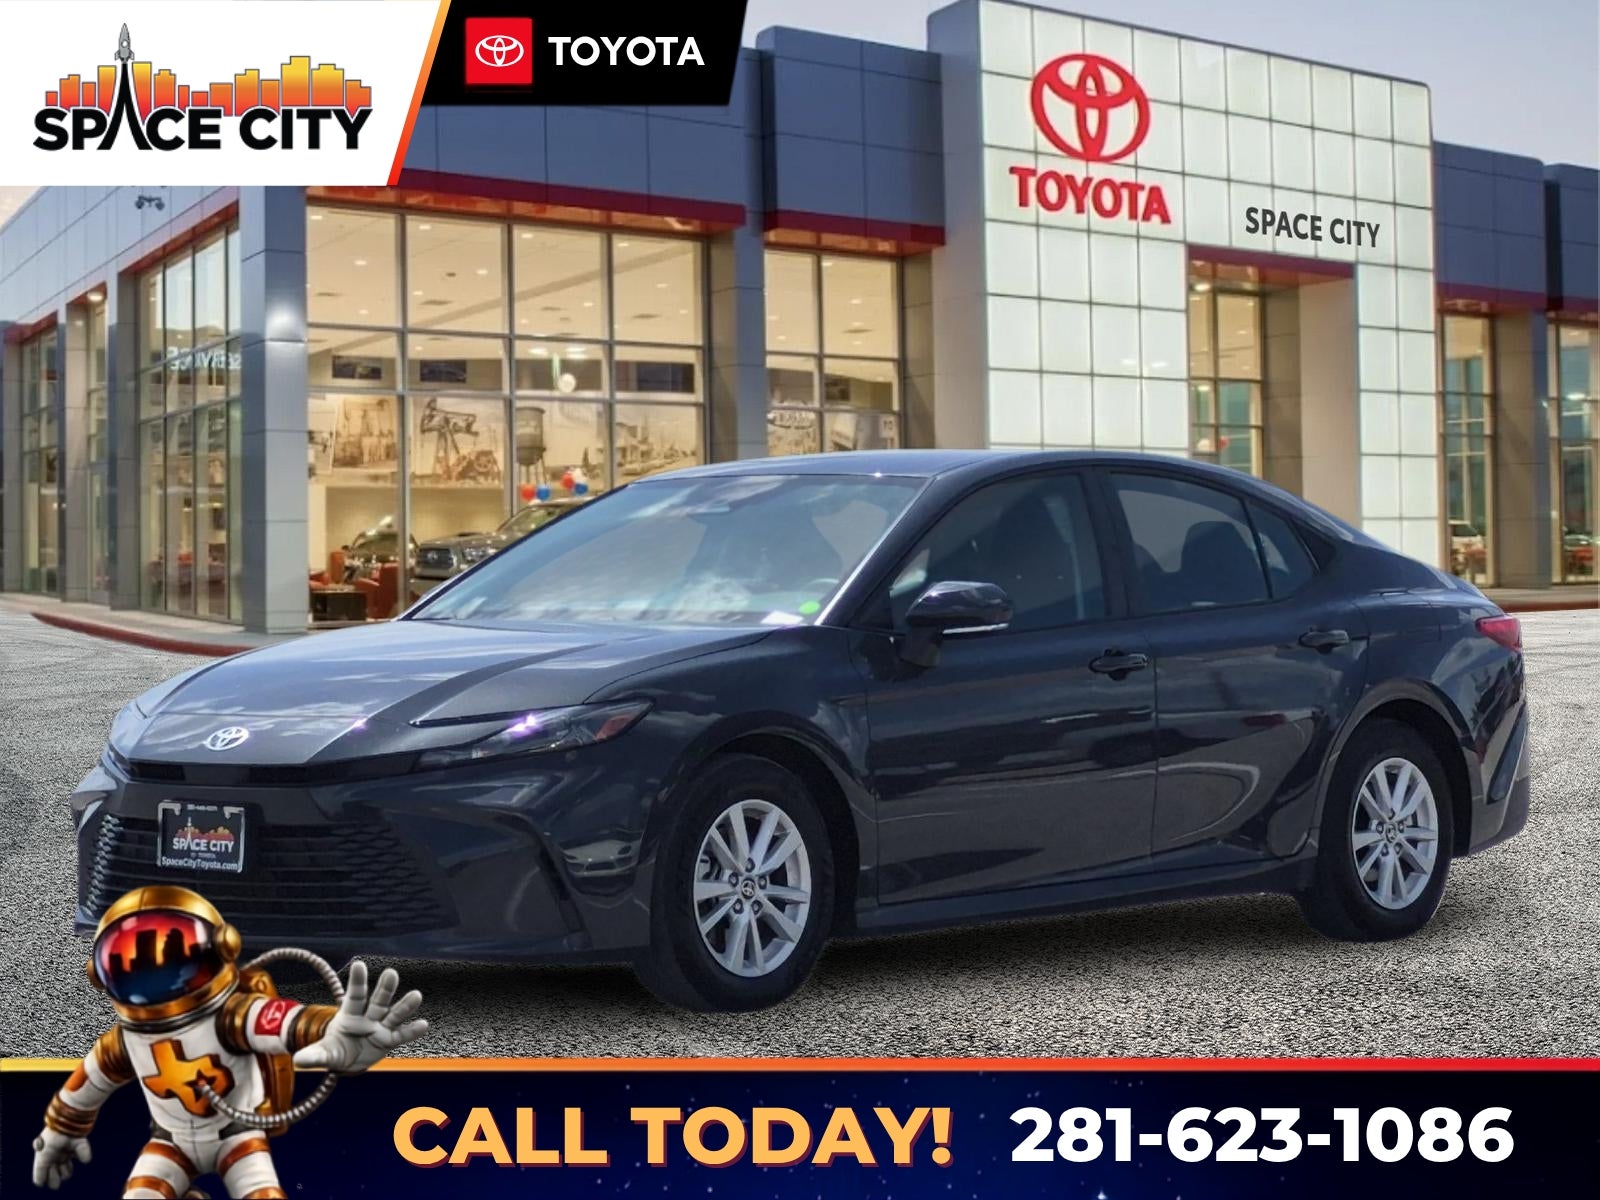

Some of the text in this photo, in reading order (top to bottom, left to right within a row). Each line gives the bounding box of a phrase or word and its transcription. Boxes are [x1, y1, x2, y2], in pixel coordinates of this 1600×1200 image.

[1009, 165, 1172, 225] TOYOTA
[1245, 206, 1381, 248] SPACE CITY
[173, 838, 233, 852] SPACE CITY
[162, 857, 237, 870] SpaceCityToyota.com
